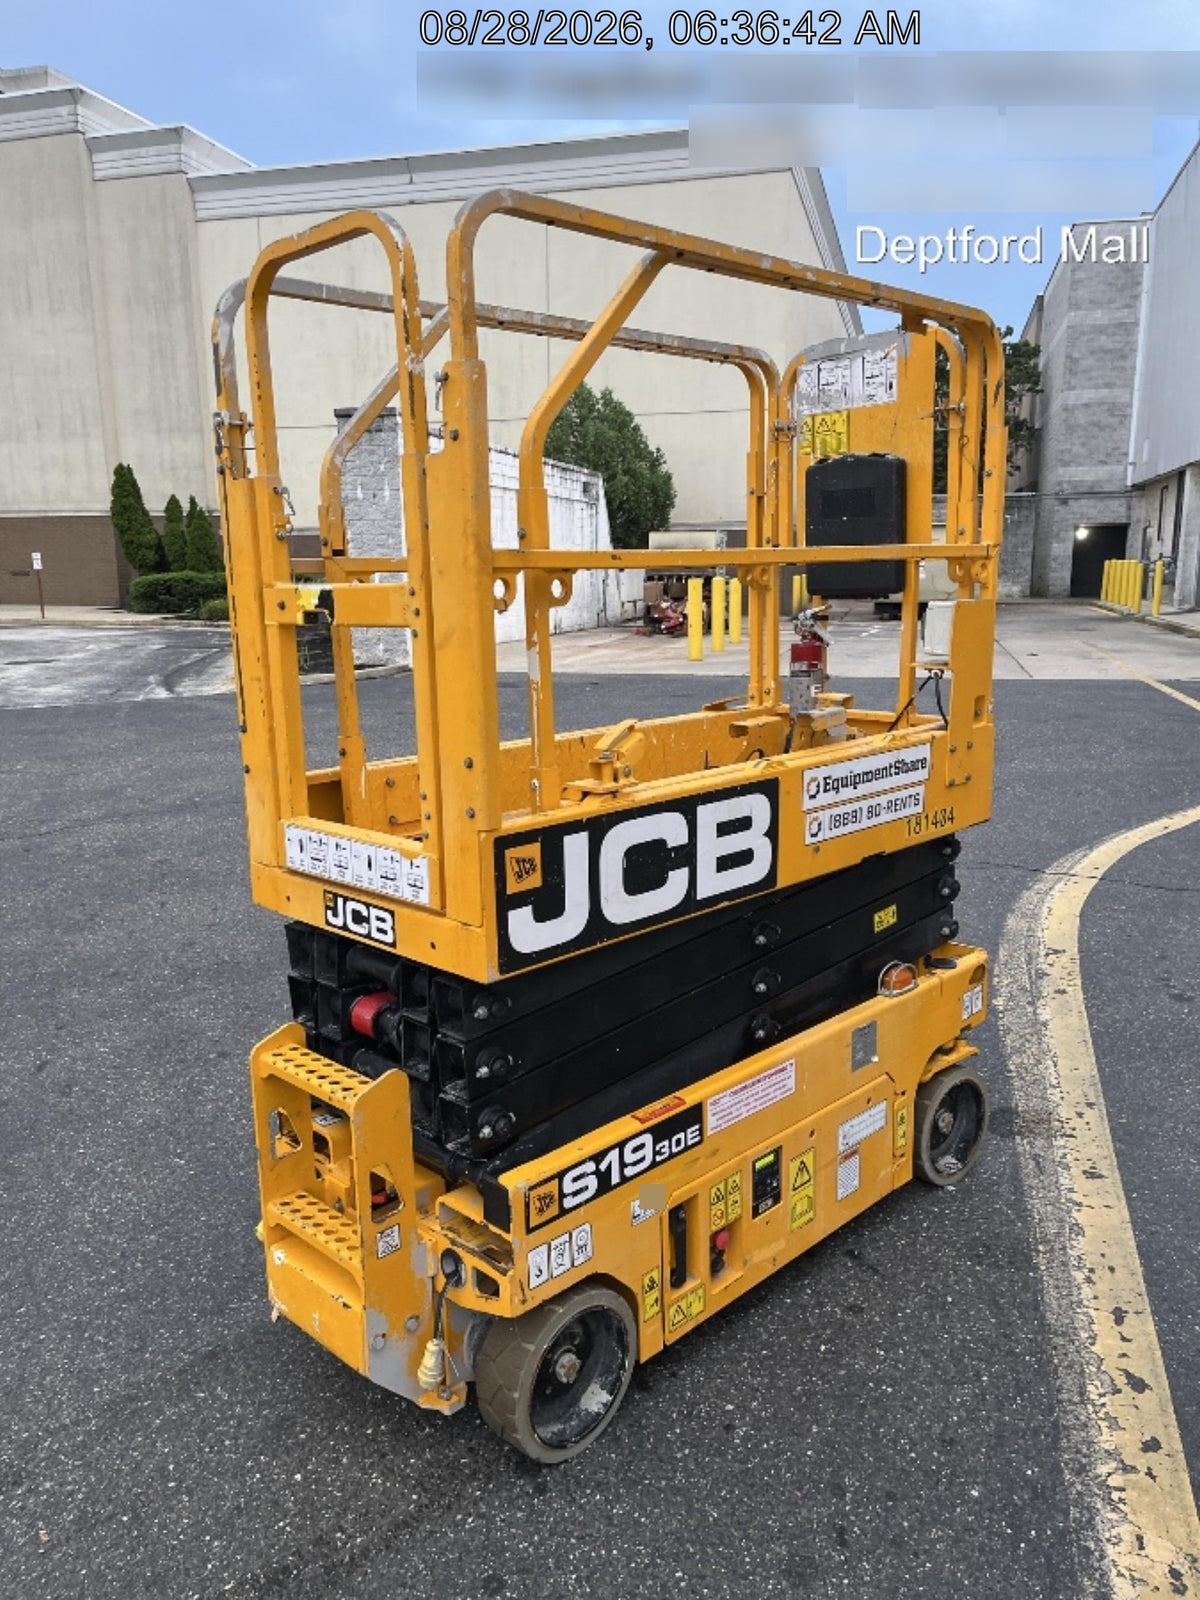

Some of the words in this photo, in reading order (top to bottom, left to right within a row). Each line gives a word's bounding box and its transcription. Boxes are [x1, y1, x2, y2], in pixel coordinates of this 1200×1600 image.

[822, 756, 928, 794] EquipmentShare
[866, 792, 921, 821] 80-RENTS
[507, 792, 773, 955] JCB
[326, 897, 394, 943] JCB
